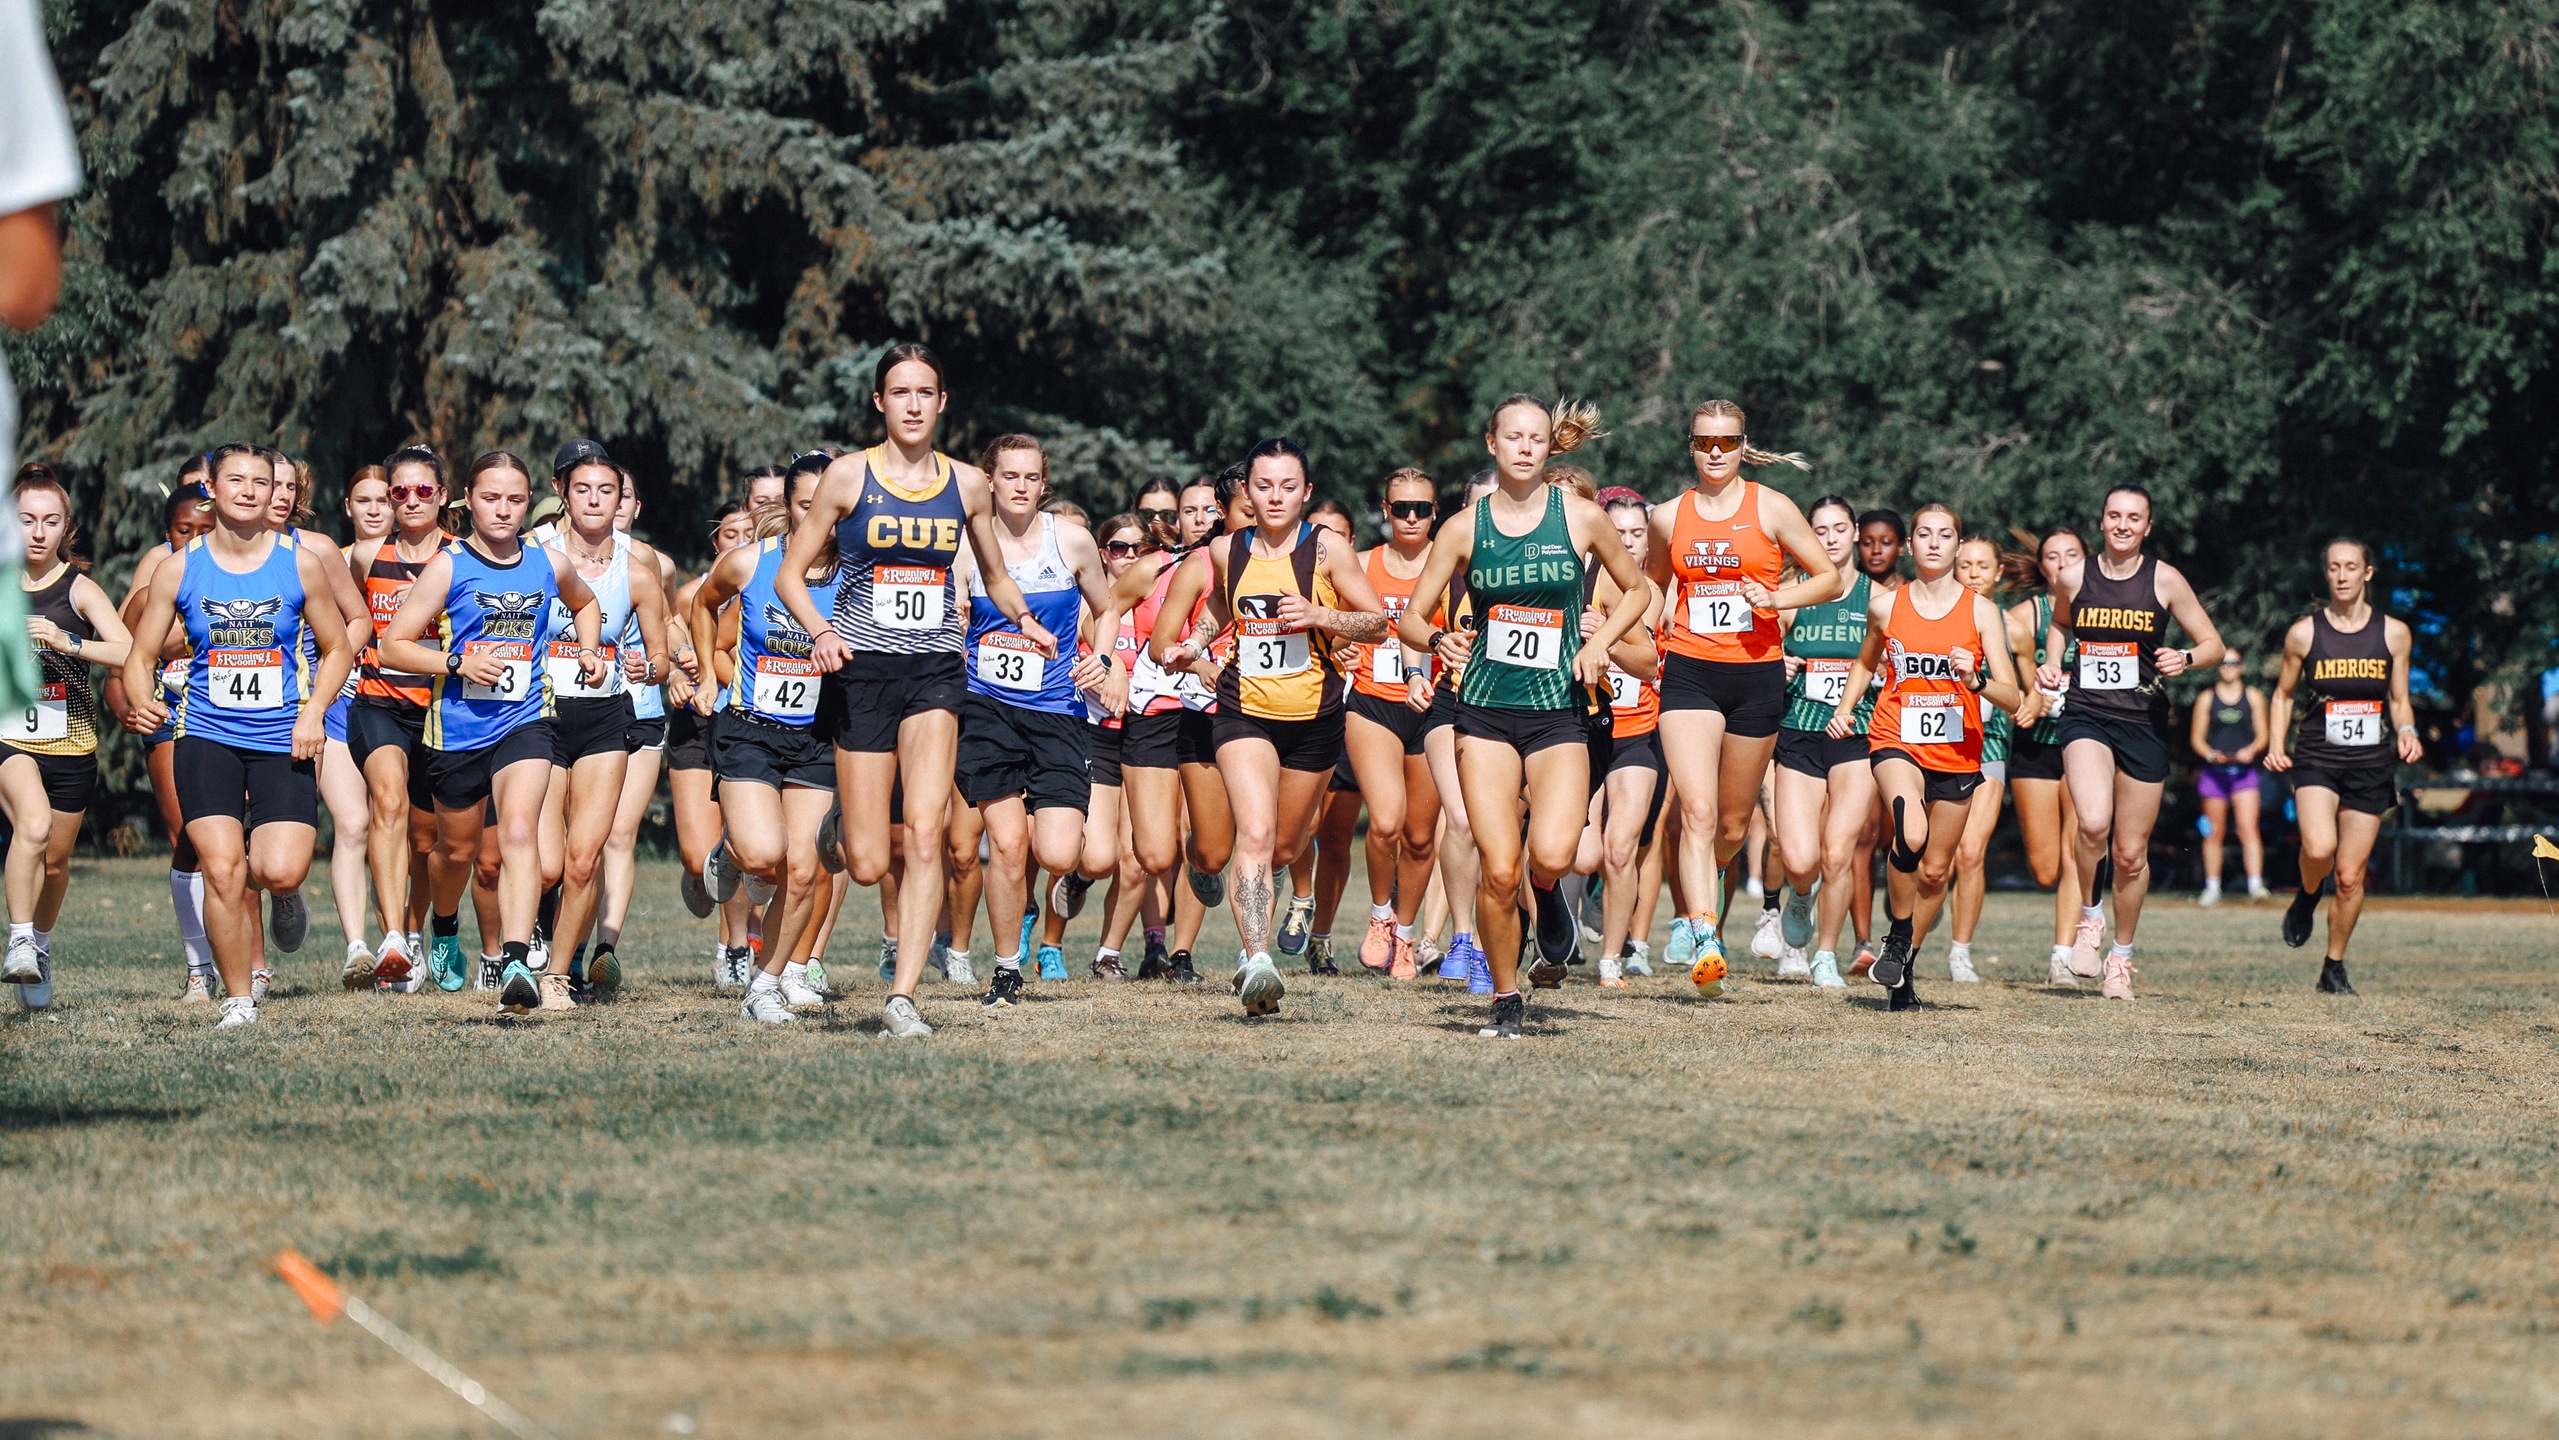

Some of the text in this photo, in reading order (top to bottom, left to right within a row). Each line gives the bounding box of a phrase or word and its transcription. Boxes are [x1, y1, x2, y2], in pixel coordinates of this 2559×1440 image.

[866, 515, 959, 552] CUE
[1684, 555, 1740, 568] VIKINGS
[890, 569, 931, 583] Running
[1471, 561, 1576, 590] QUEENS
[1700, 582, 1734, 596] Running
[895, 591, 925, 621] 50
[1505, 608, 1546, 623] Running
[1709, 601, 1732, 627] 12
[1250, 621, 1290, 635] Running
[2076, 607, 2155, 632] AMBROSE
[210, 628, 274, 646] OOKS
[766, 637, 813, 657] OOK
[786, 632, 811, 642] NAIT
[994, 634, 1031, 648] Running
[1506, 629, 1540, 660] 20
[223, 652, 265, 667] Running
[1258, 640, 1287, 669] 37
[1393, 654, 1400, 677] 1
[773, 660, 812, 673] Running
[995, 653, 1025, 682] 33
[1905, 656, 1960, 679] GOA
[2097, 661, 2121, 683] 53
[2314, 658, 2387, 680] AMBROSE
[229, 673, 262, 701] 44
[574, 667, 586, 690] 4
[1824, 677, 1847, 700] 25
[775, 680, 806, 709] 42
[25, 706, 39, 733] 9
[1920, 712, 1946, 737] 62
[2343, 719, 2365, 740] 54
